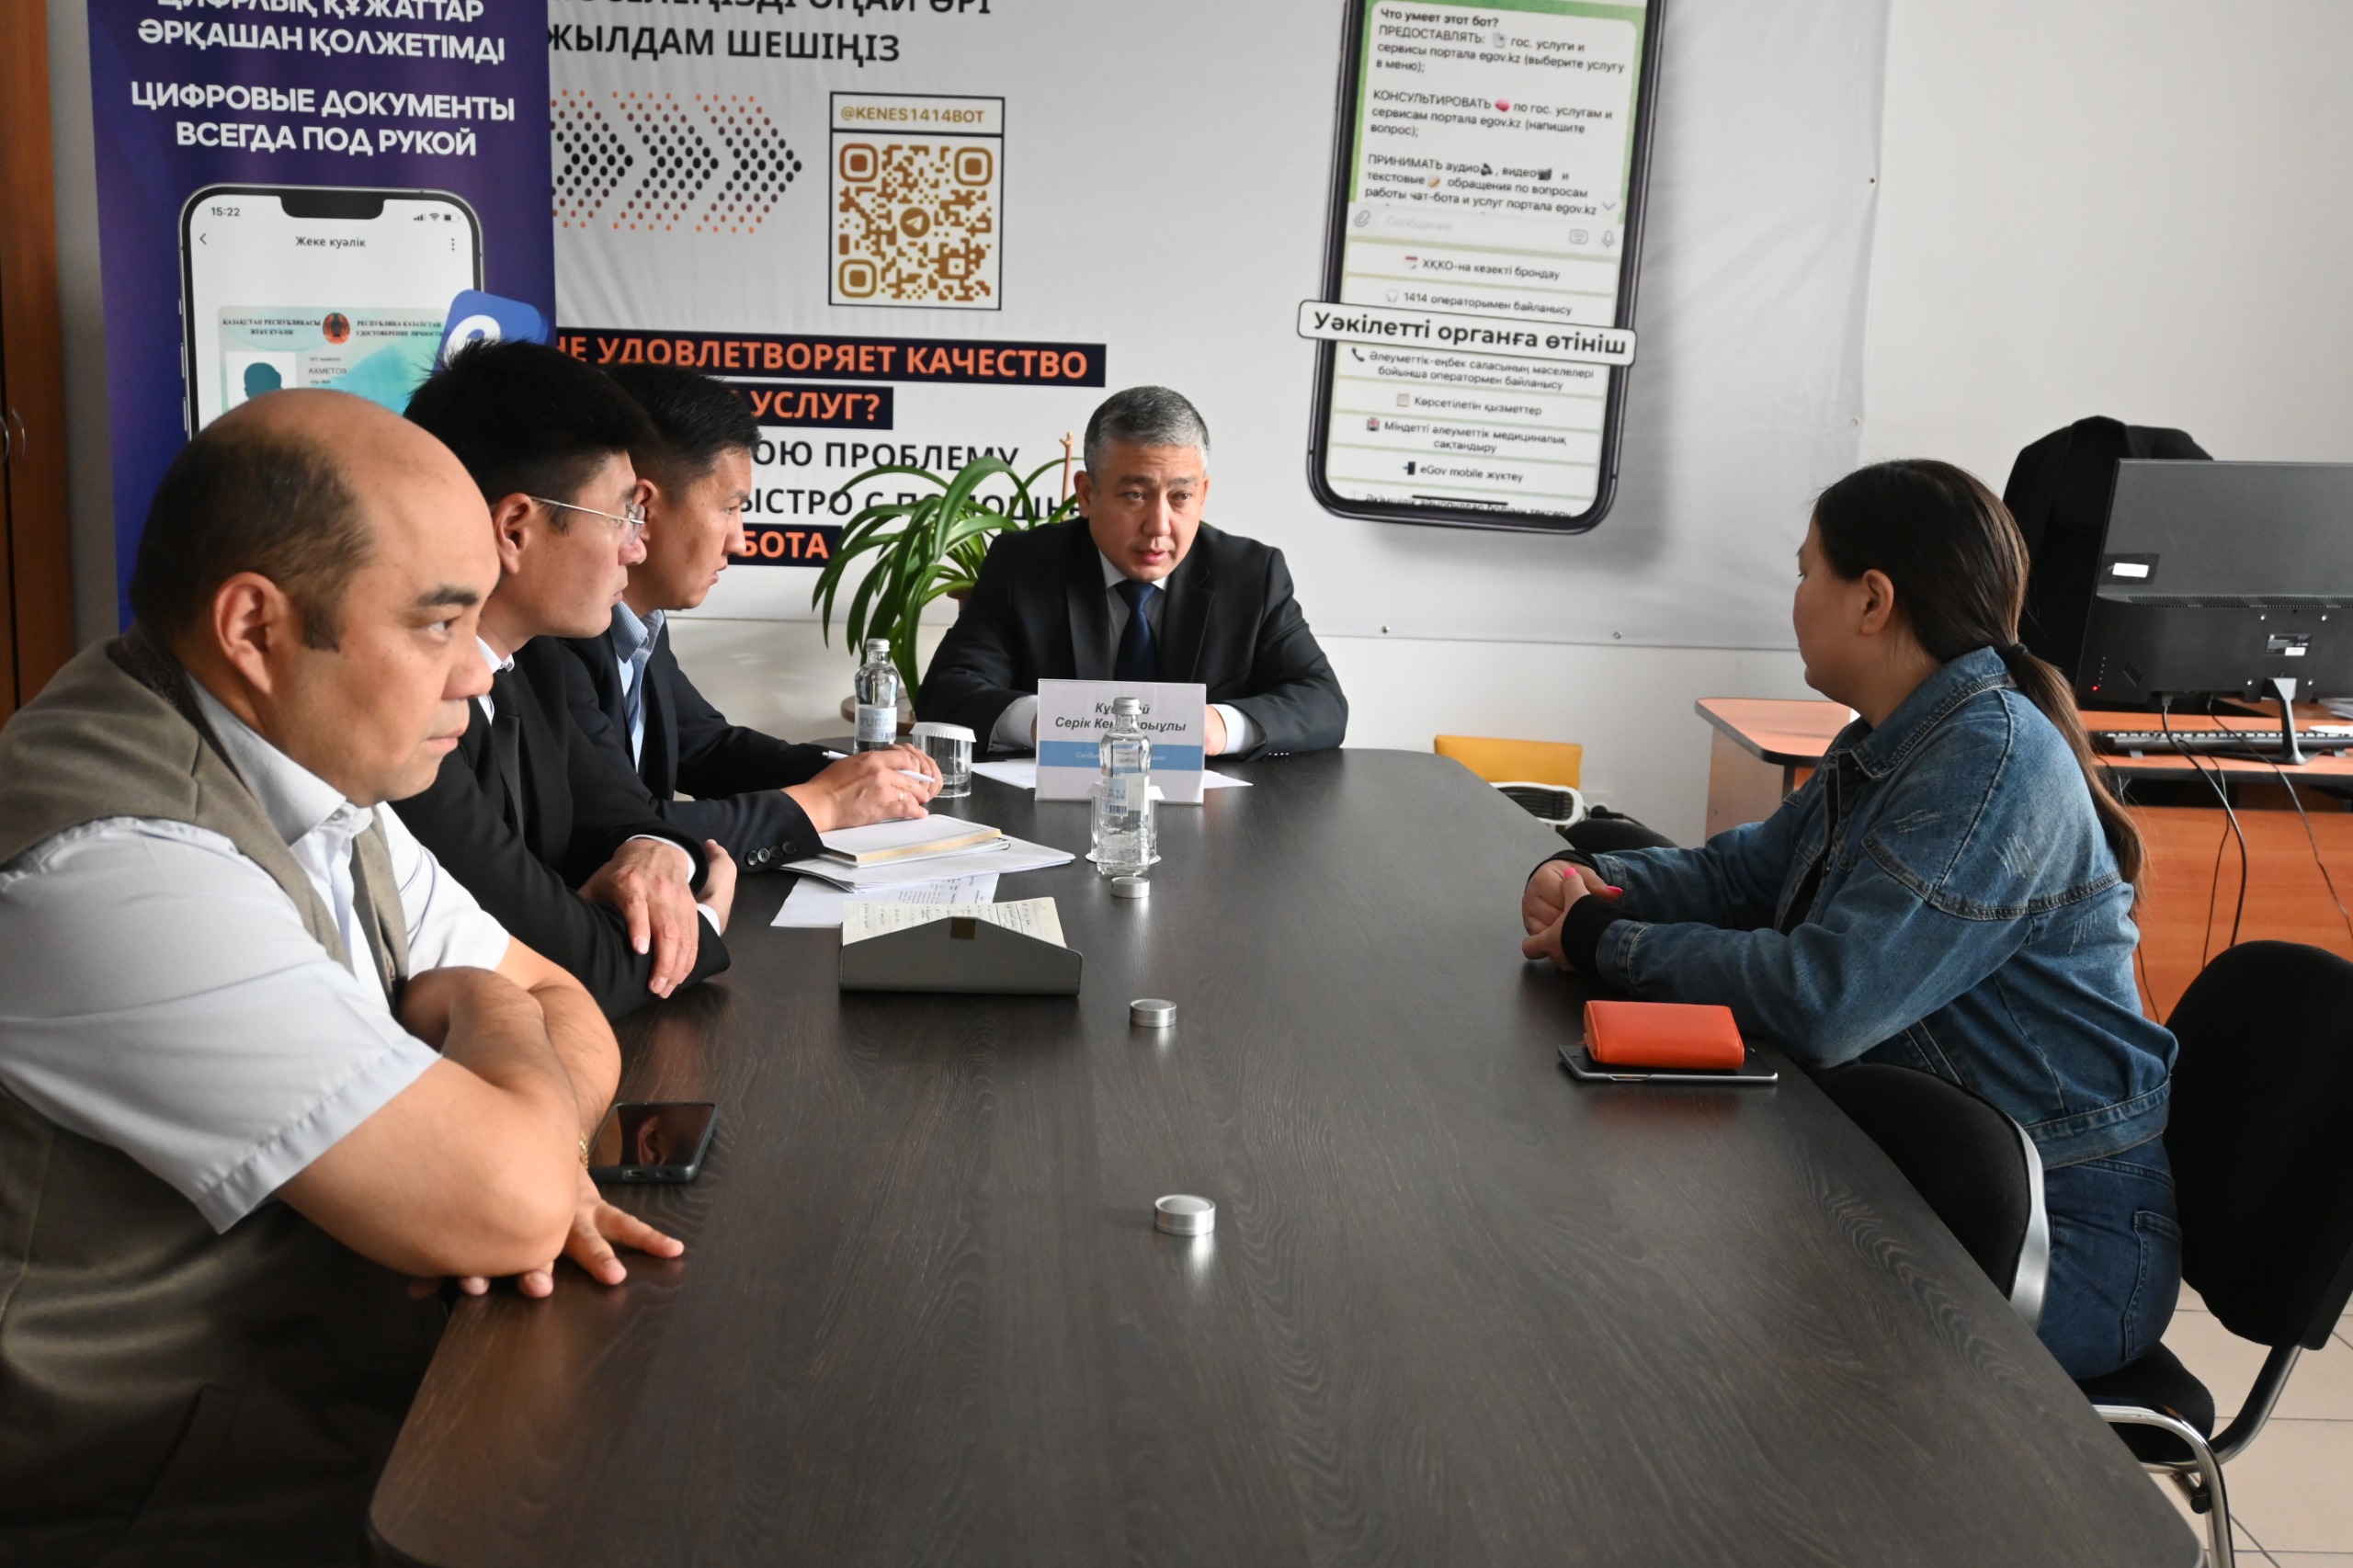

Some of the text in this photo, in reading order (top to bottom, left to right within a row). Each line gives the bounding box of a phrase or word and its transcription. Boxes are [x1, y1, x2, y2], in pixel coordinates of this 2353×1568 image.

[1381, 8, 1499, 28] Что умеет этот бот?
[138, 18, 506, 65] ӘРҚАШАН ҚОЛЖЕТІМДІ
[547, 24, 900, 68] ЖЫЛДАМ ШЕШІҢІЗ
[1379, 25, 1585, 52] ПРЕДОСТАВЛЯТЬ: гос. услуги и
[1376, 60, 1425, 73] в меню);
[1378, 43, 1625, 74] сервисы портала egov.kz (выберите услугу
[131, 81, 516, 121] ЦИФРОВЫЕ ДОКУМЕНТЫ
[1373, 89, 1491, 109] КОНСУЛЬТИРОВАТЬ
[1514, 103, 1528, 112] по
[1531, 105, 1552, 115] гос.
[1556, 107, 1602, 119] услугам
[841, 106, 984, 123] @KENES1414BOT
[1371, 108, 1586, 133] сервисам портала egov.kz (напишите
[176, 120, 476, 156] ВСЕГДА ПОД РУКОЙ
[1370, 123, 1419, 137] вопрос);
[1368, 153, 1443, 170] ПРИНИМАТЬ
[1446, 163, 1480, 173] аудио
[1502, 167, 1537, 177] видео
[1368, 172, 1587, 198] текстовые обращения по вопросам
[210, 207, 241, 217] 15:22
[1365, 187, 1407, 199] работы
[1410, 191, 1460, 203] чат-бота
[1472, 197, 1504, 209] услуг
[1506, 199, 1552, 211] портала
[1556, 203, 1597, 216] egov.kz
[295, 235, 367, 249] Жеке куәлік
[1422, 259, 1560, 280] ХҚКО-на кезекті брондау
[1404, 292, 1572, 316] 1414 операторымен байланысу
[1314, 311, 1626, 355] Уәкілетті органға өтініш
[597, 336, 896, 372] УДОВЛЕТВОРЯЕТ
[906, 347, 1087, 379] КАЧЕСТВО
[1379, 366, 1563, 391] бойынша оператормен байланысу
[750, 390, 880, 421] УСЛУГ?
[1484, 403, 1542, 416] қызметтер
[1384, 421, 1429, 434] Міндетті
[1493, 431, 1566, 446] медициналық
[1434, 439, 1497, 454] сақтандыру
[1420, 464, 1447, 475] eGov
[1449, 468, 1483, 479] mobile
[741, 488, 853, 516] ЫСТРО
[1055, 717, 1091, 730] Серік
